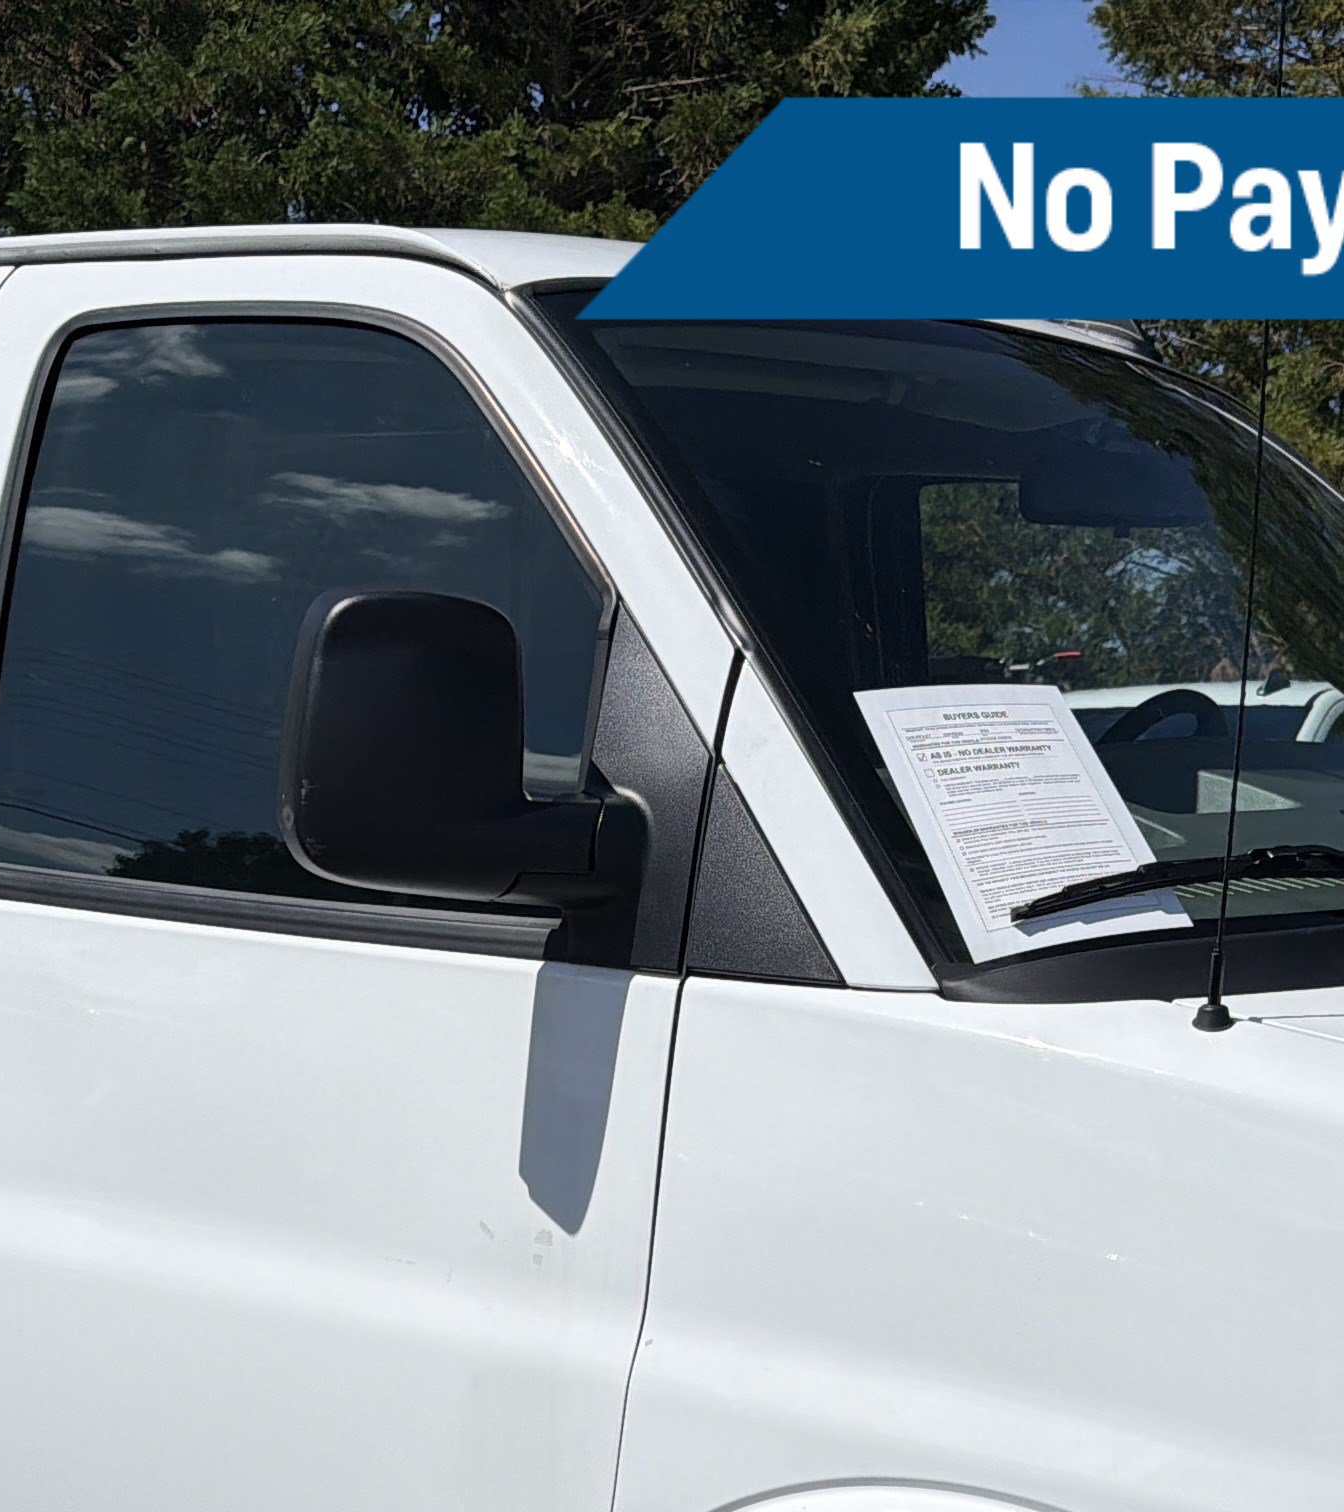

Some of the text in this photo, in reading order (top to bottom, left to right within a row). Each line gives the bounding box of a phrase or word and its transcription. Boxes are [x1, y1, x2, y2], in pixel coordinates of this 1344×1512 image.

[943, 710, 1009, 721] BUYERS GUIDE
[930, 751, 943, 759] AS
[958, 749, 971, 757] NO
[972, 746, 1006, 755] DEALER
[1006, 745, 1052, 753] WARRANTY
[937, 761, 1020, 776] DEALER WARRANTY
